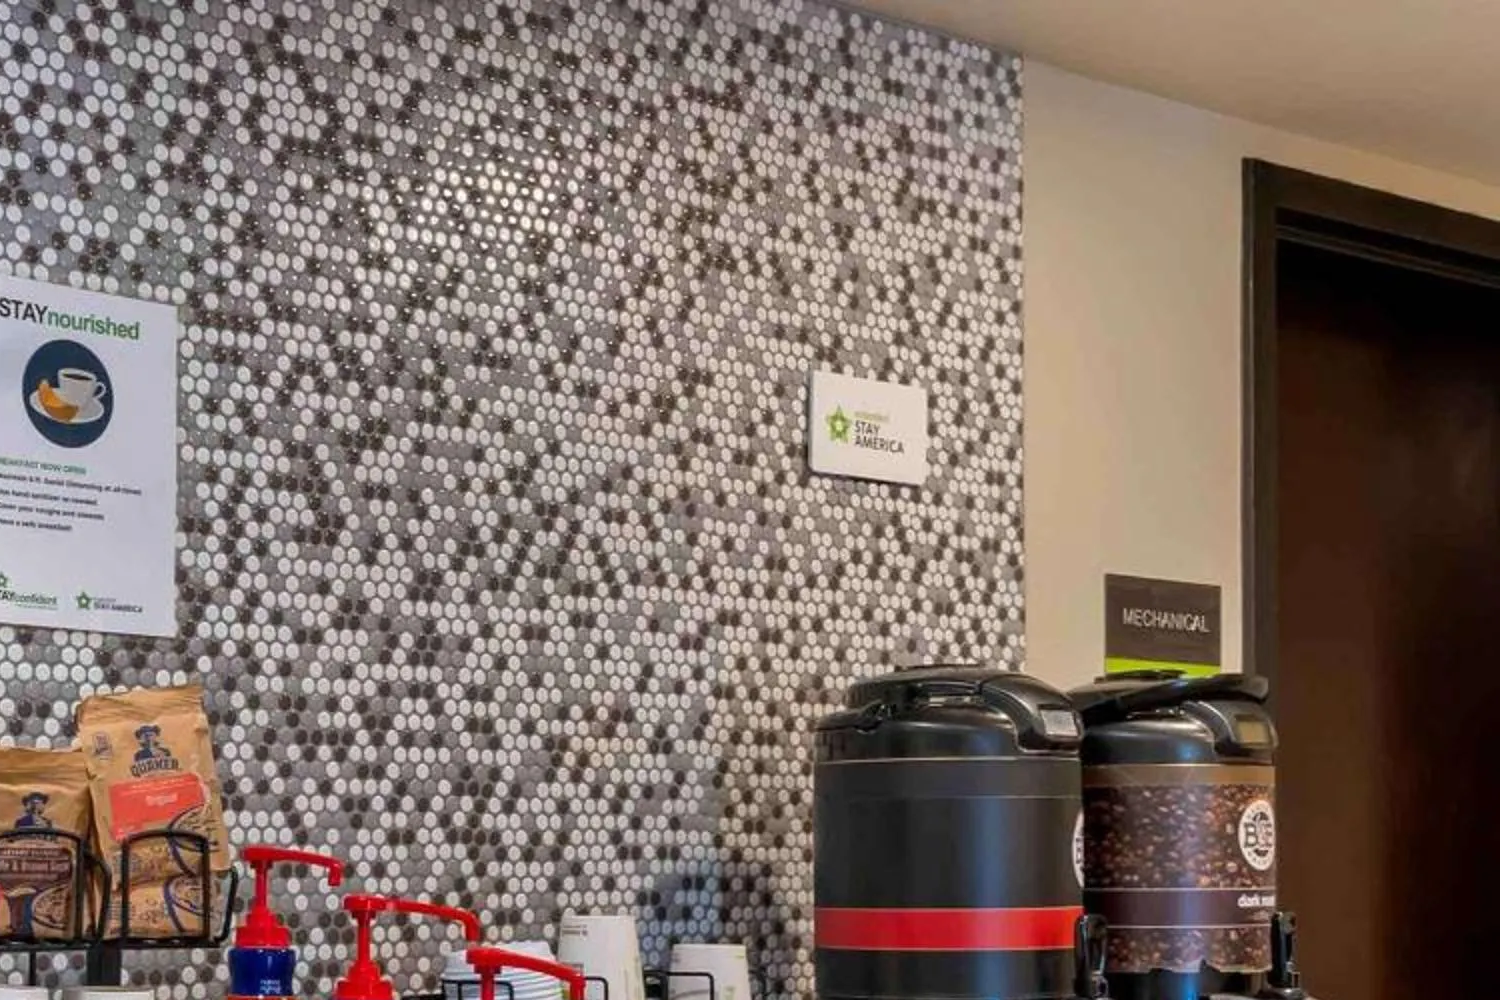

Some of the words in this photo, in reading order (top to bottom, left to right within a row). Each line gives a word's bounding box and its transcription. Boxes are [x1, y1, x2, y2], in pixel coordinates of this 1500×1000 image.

[855, 420, 880, 434] STAY
[855, 436, 905, 454] AMERICA
[1123, 607, 1210, 633] MECHANICAL
